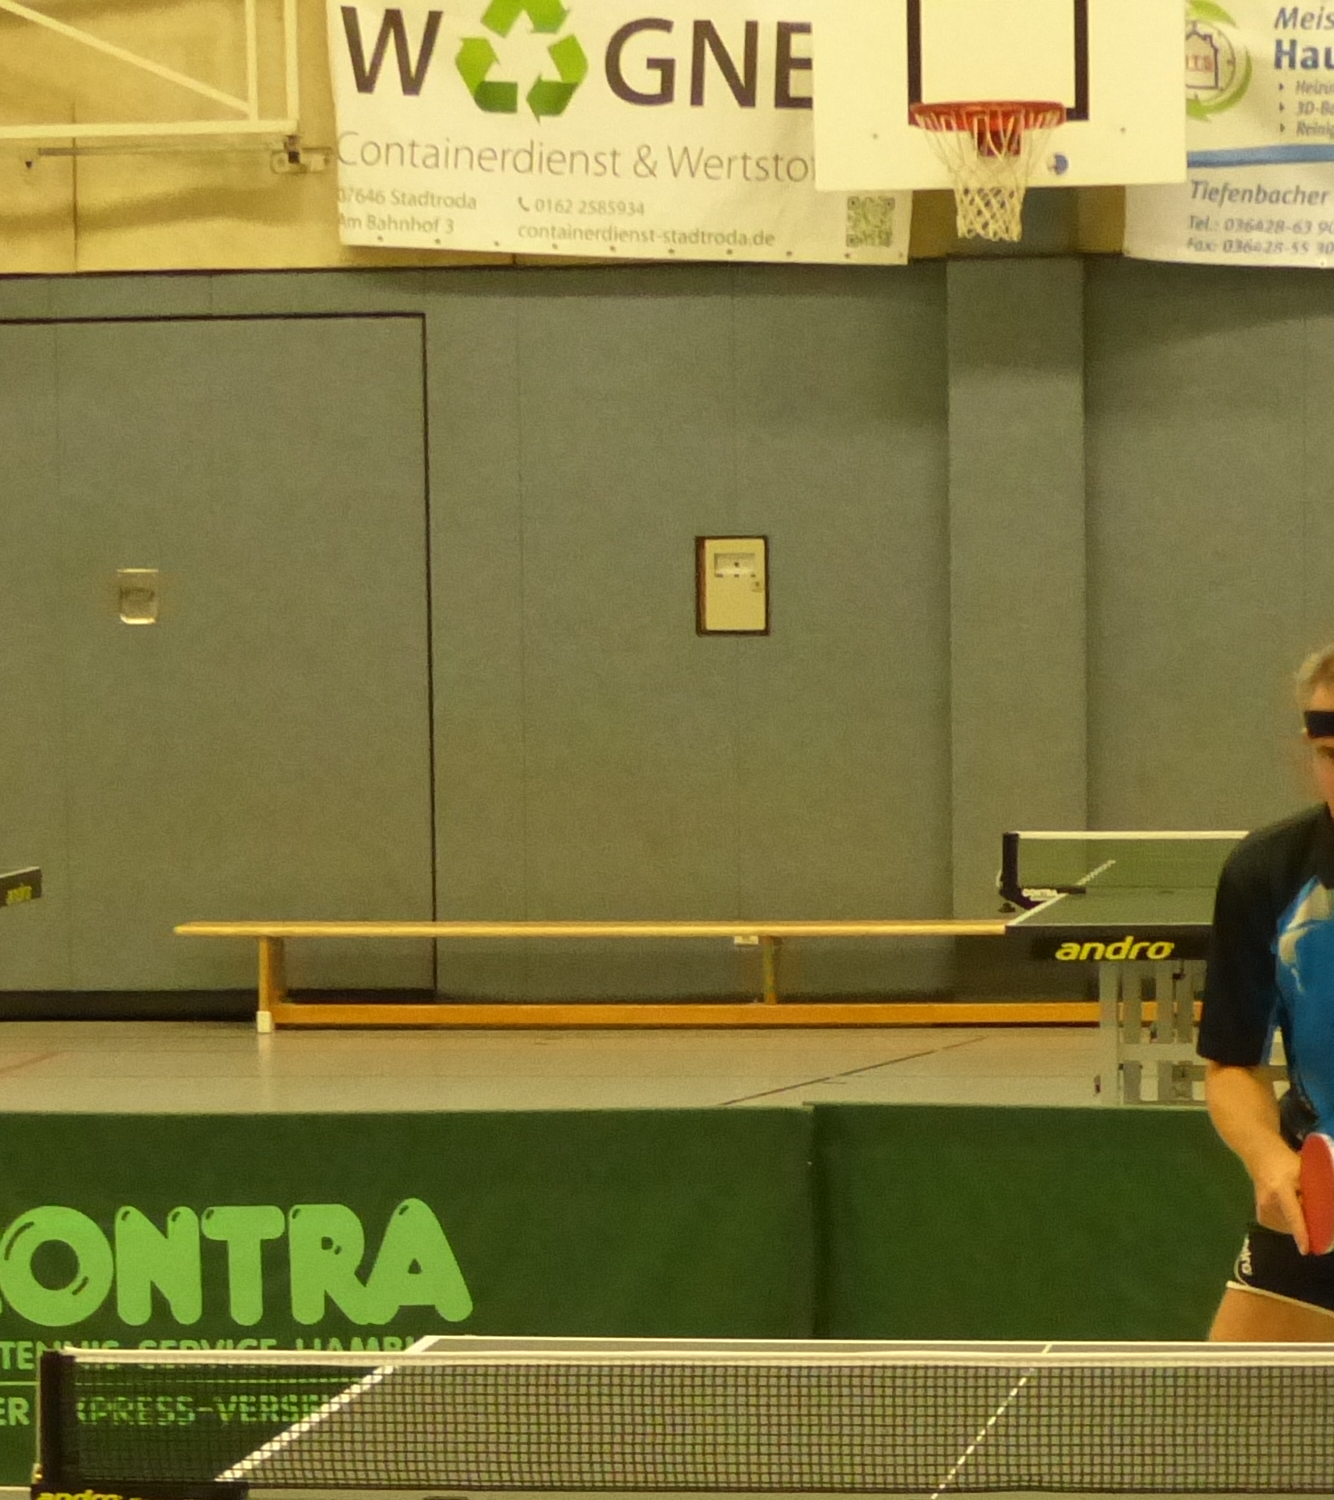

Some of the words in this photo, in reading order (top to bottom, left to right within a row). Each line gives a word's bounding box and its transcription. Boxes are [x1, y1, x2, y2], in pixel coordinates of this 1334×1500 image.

[338, 130, 621, 179] Containerdienst
[633, 143, 658, 179] &
[667, 144, 815, 184] Wertsto
[391, 189, 478, 210] Stadtroda
[1190, 179, 1330, 208] Tiefenbacher
[1055, 935, 1175, 961] andro
